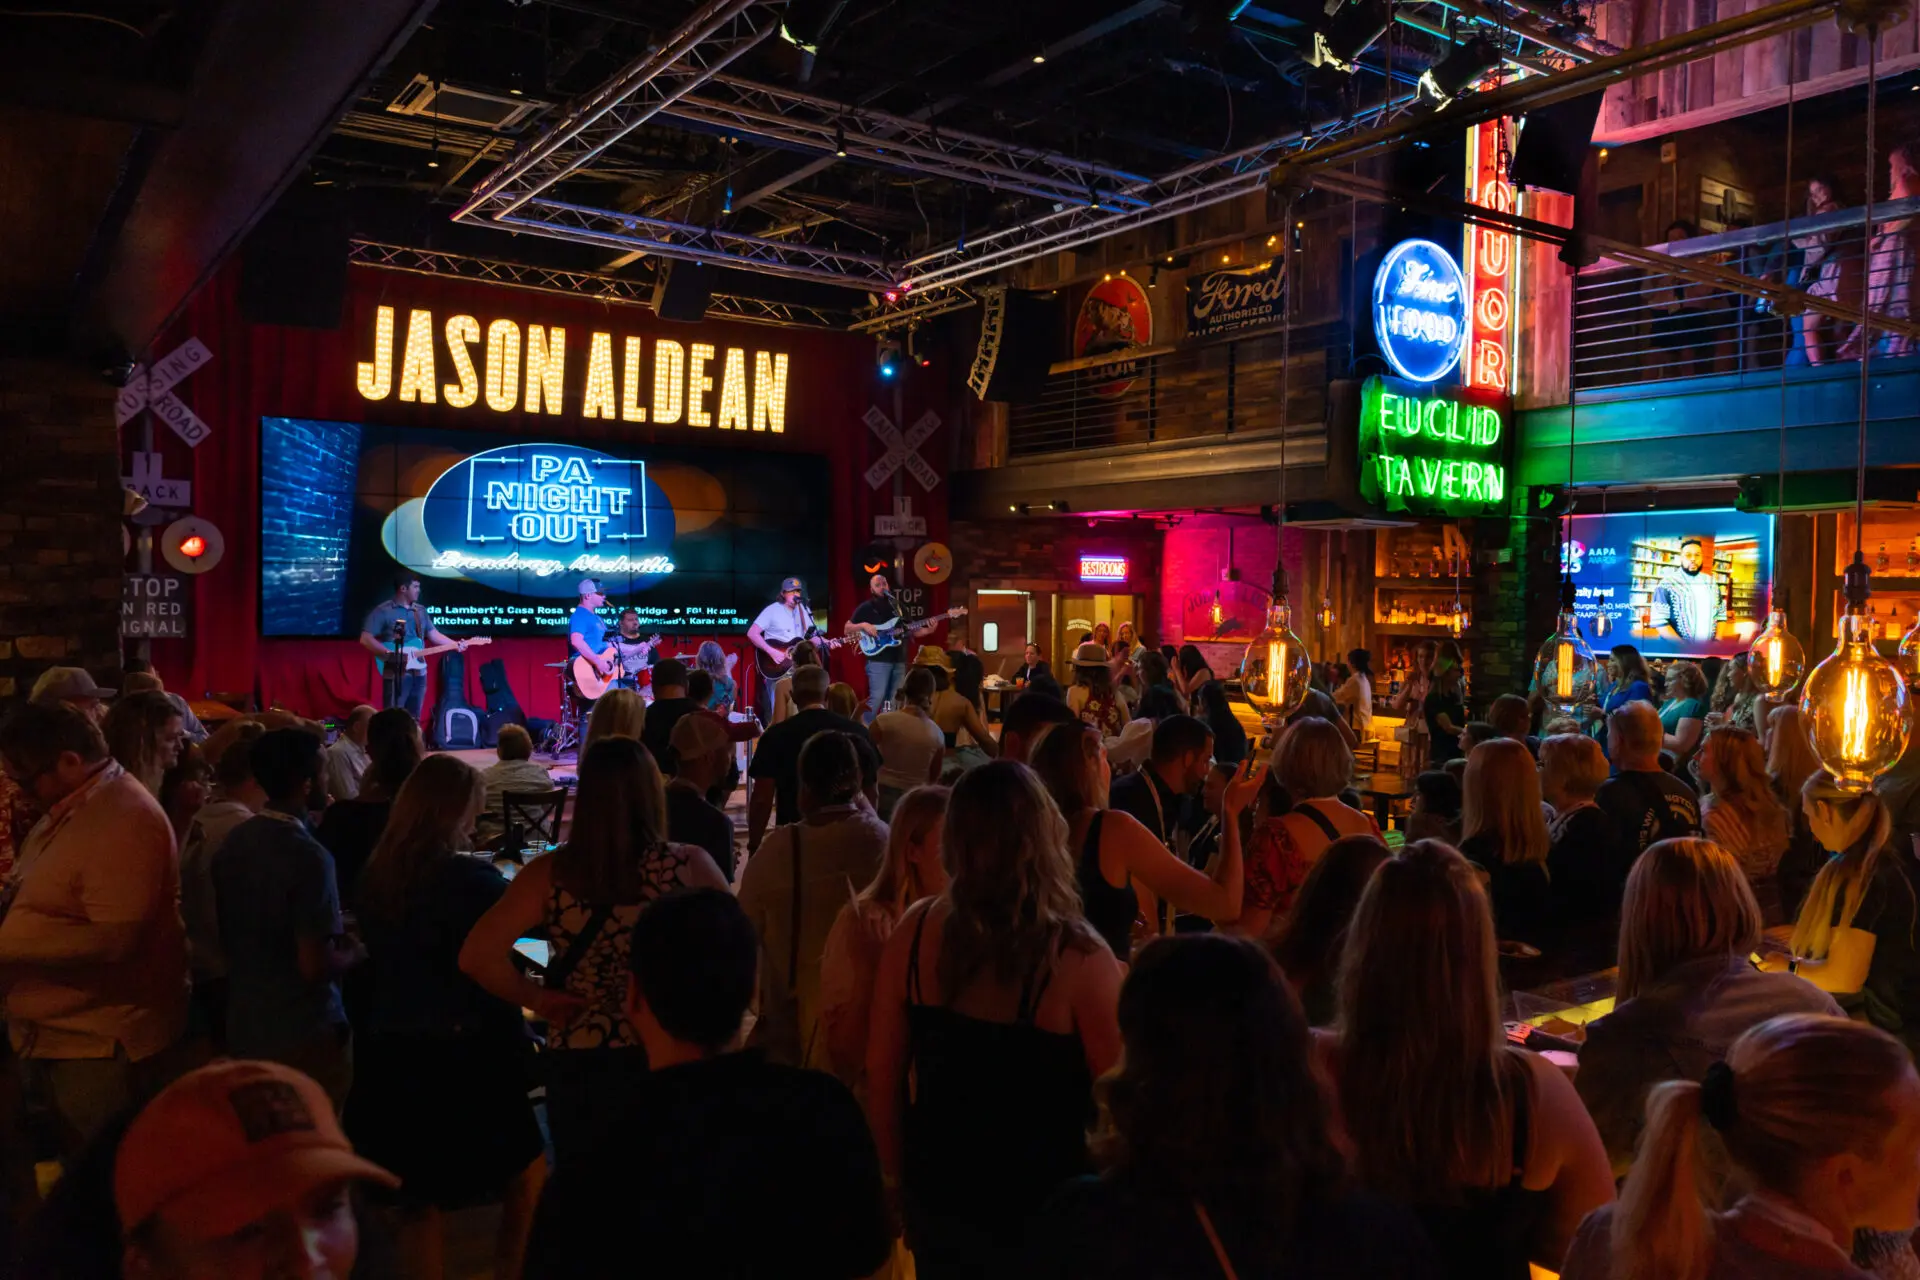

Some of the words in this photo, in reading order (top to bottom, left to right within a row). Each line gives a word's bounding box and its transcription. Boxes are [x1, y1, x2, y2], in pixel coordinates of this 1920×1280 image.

[1193, 258, 1286, 319] Ford
[1397, 260, 1457, 303] Fine
[1209, 304, 1273, 325] AUTHORIZED
[1390, 304, 1457, 345] FOOD
[356, 305, 566, 416] JASON
[582, 331, 790, 434] ALDEAN
[1380, 392, 1502, 446] EUCLID
[530, 454, 593, 484] PA
[1379, 454, 1505, 502] TAVERN
[486, 481, 632, 515] NIGHT
[511, 512, 609, 544] OUT
[568, 553, 675, 574] Nashville
[1588, 547, 1616, 556] AAPA
[1081, 561, 1126, 576] RESTROOMS
[122, 577, 181, 597] TOP
[147, 601, 182, 616] RED
[433, 616, 479, 625] Kitchen
[482, 616, 491, 625] &
[494, 616, 514, 625] Bar
[731, 616, 749, 625] Bar
[445, 605, 505, 615] Lambert's
[506, 606, 534, 614] Casa
[537, 606, 564, 614] Rosa
[121, 619, 182, 635] IGNAL
